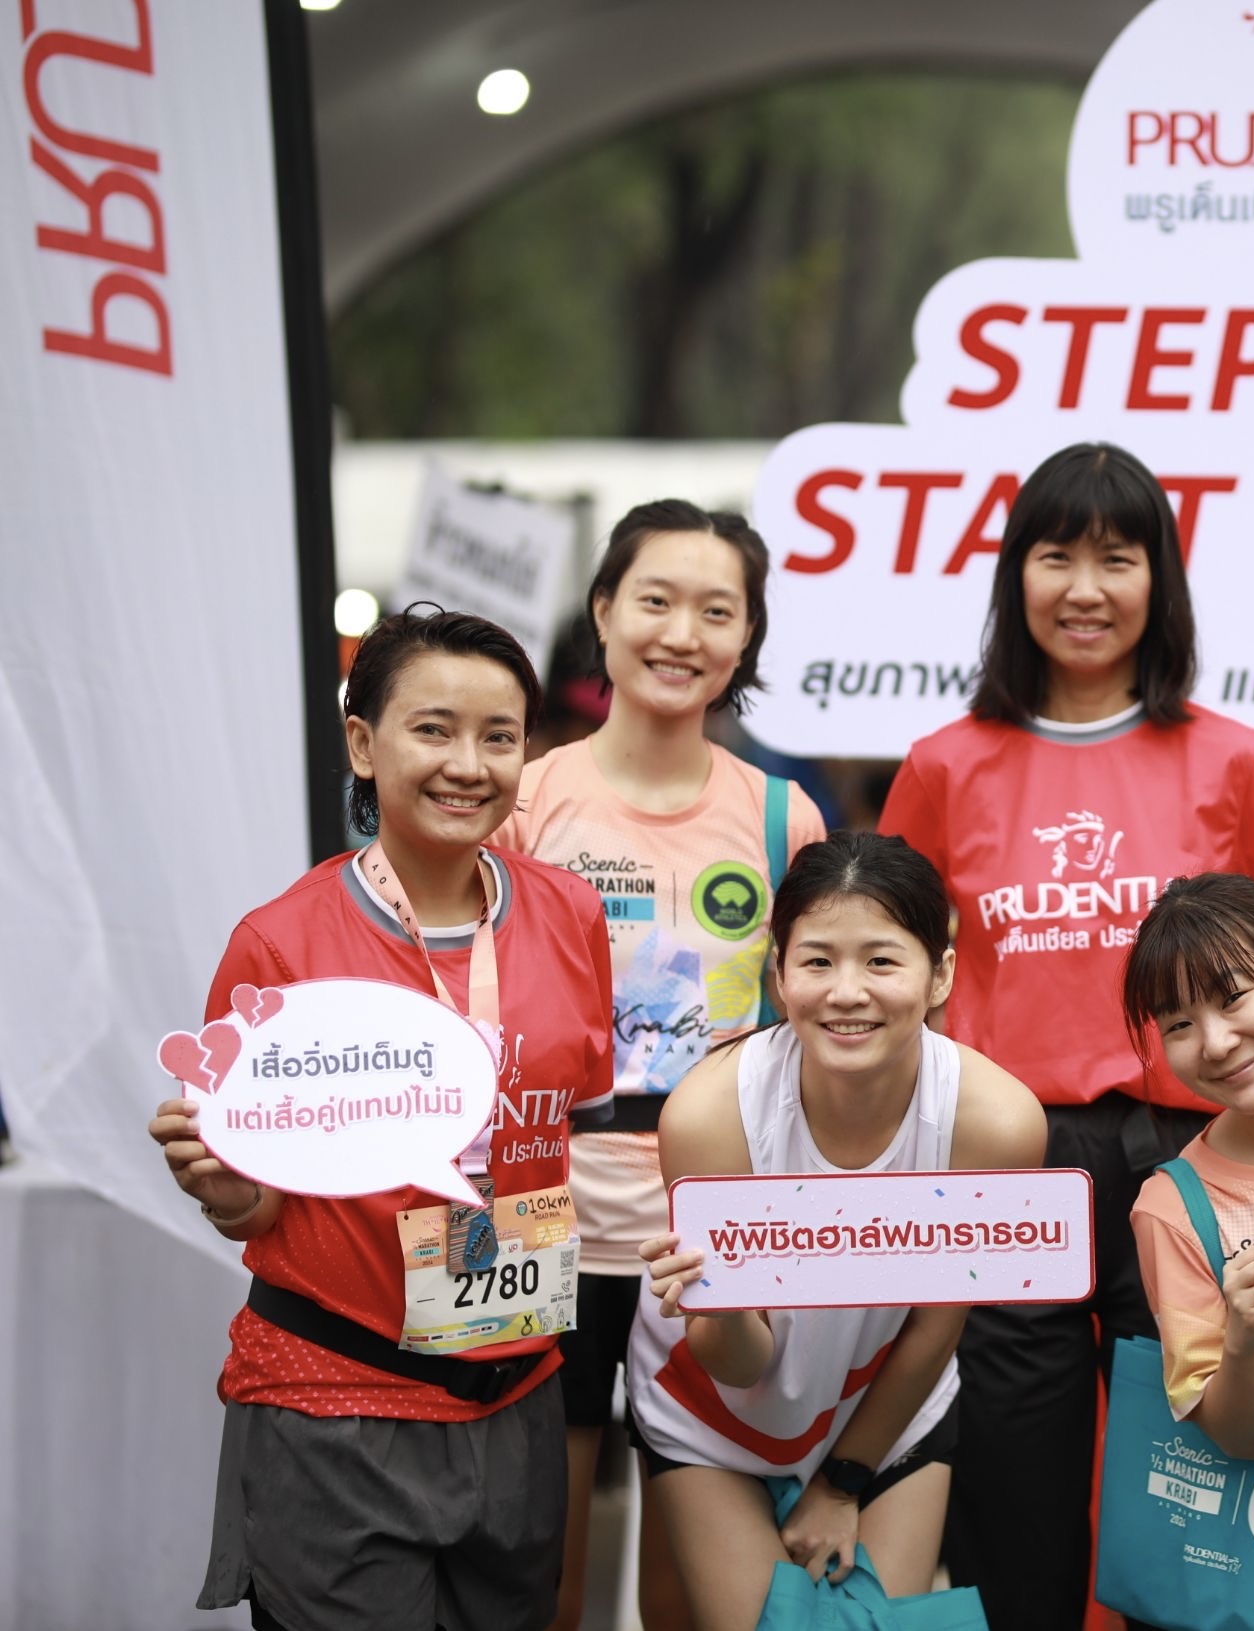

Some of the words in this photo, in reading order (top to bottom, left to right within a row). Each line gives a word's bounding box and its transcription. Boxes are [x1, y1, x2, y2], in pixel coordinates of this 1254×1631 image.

[784, 469, 1238, 575] STAT
[567, 852, 637, 873] Scenic
[587, 877, 656, 893] ARATHON
[252, 1040, 434, 1078] เสื้อวิ่งมีเต็มตู้
[226, 1085, 462, 1132] แต่เสื้อคู่(แทบ)ไม่มี
[529, 1195, 571, 1213] 10km
[709, 1216, 1063, 1262] ผู้พิชิตฮาล์ฟมาราธอน
[454, 1260, 538, 1308] 2780
[1164, 1437, 1213, 1465] Scenic
[1165, 1458, 1226, 1489] MARATHON
[1165, 1480, 1198, 1506] KRABI
